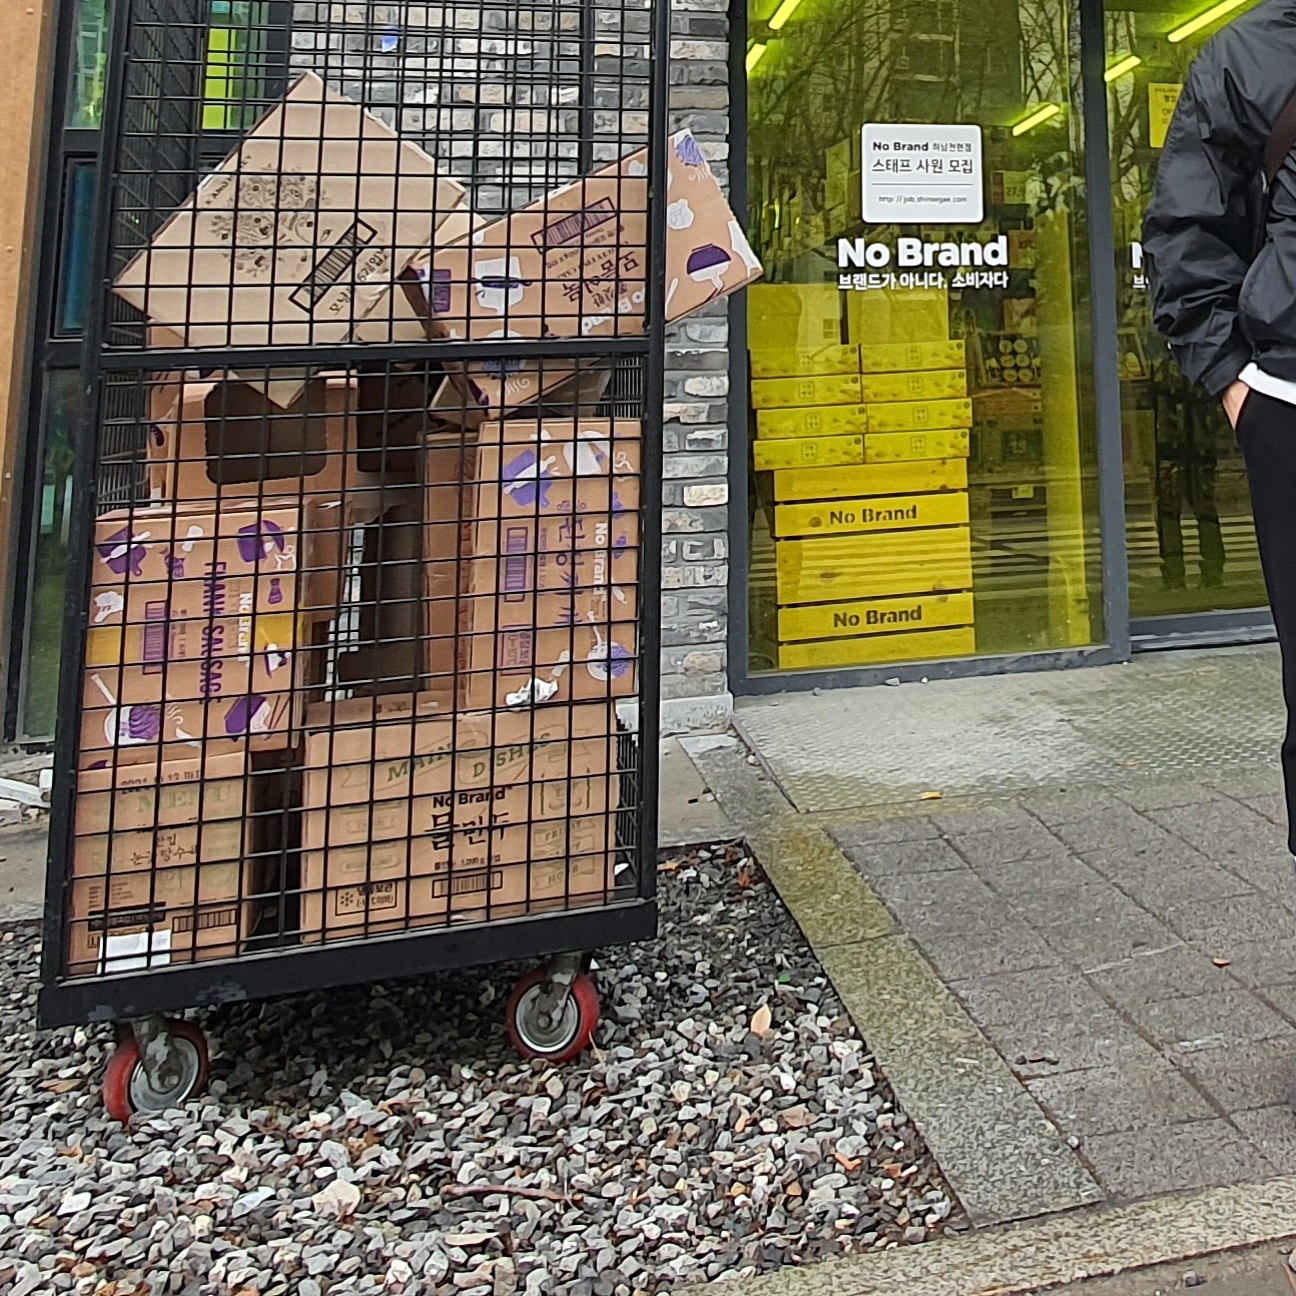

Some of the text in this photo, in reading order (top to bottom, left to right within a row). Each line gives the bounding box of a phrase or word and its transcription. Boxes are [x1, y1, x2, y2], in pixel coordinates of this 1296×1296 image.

[872, 141, 890, 151] No
[893, 141, 929, 151] Brand
[871, 158, 973, 174] 스태프 사원 모집
[838, 236, 1008, 267] No Brand
[838, 273, 897, 289] 브랜드가
[952, 271, 1009, 289] 소비자다
[829, 505, 917, 525] No Brand
[594, 522, 608, 545] No
[833, 605, 922, 628] No Brand
[472, 732, 551, 778] DSHS
[458, 787, 506, 805] Brand
